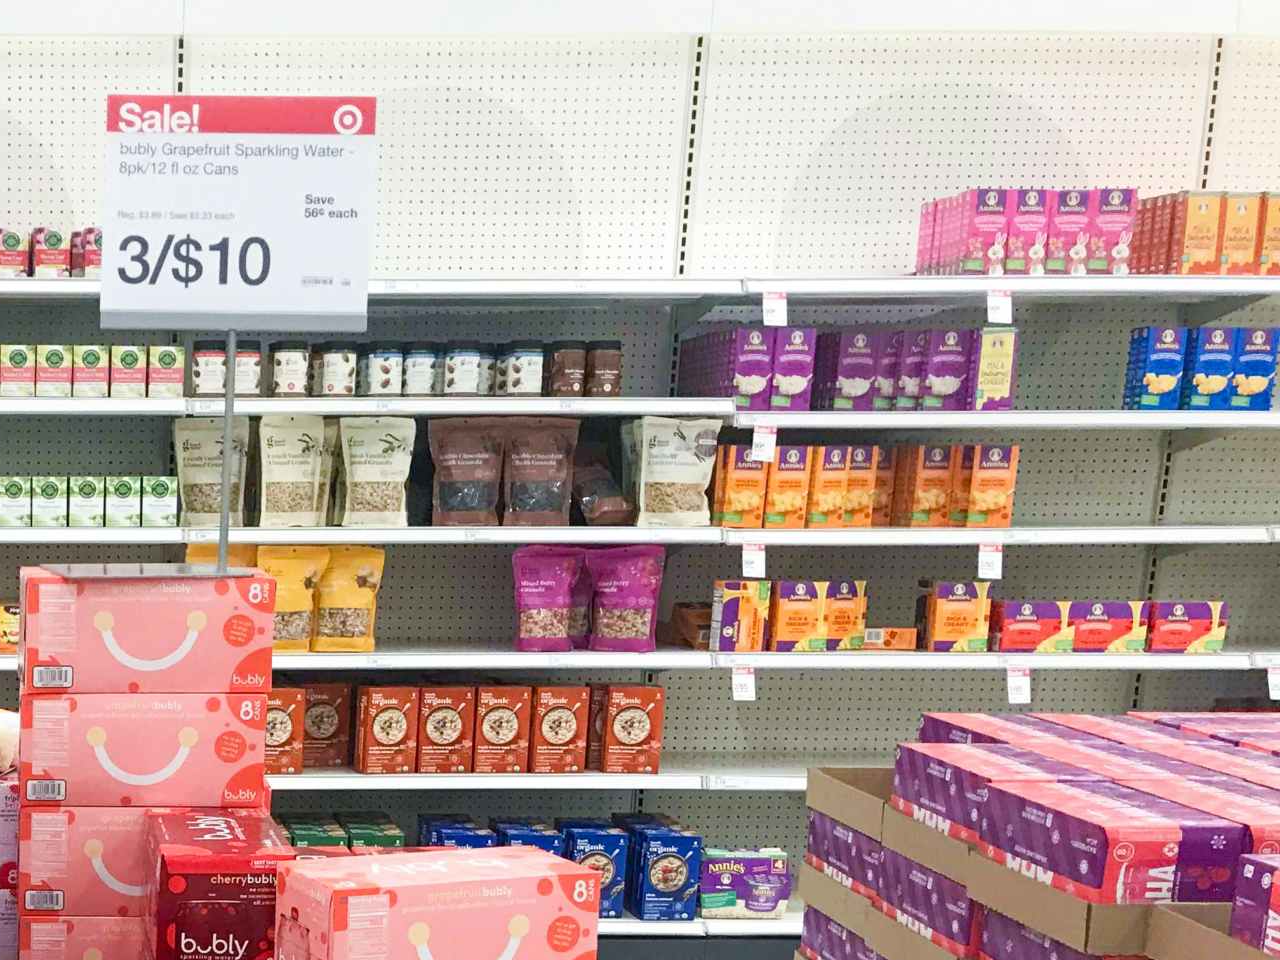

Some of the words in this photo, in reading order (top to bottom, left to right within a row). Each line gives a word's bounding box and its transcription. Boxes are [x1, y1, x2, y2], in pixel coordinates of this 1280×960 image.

[118, 102, 200, 133] Sale!
[120, 142, 156, 157] bubly
[161, 143, 230, 157] Grapefruit
[234, 144, 300, 160] Sparkling
[303, 145, 345, 158] Water
[119, 162, 167, 176] 8pk/12
[170, 162, 180, 175] fl
[183, 165, 199, 175] oz
[203, 163, 239, 176] Cans
[305, 194, 335, 205] Save
[328, 208, 358, 218] each
[117, 234, 271, 288] 3/$10
[248, 583, 263, 604] 8
[232, 674, 265, 686] bubly
[240, 700, 254, 721] 8
[224, 789, 257, 802] bubly
[709, 860, 747, 874] Annie's
[573, 880, 588, 902] 8
[181, 932, 249, 960] bubly
